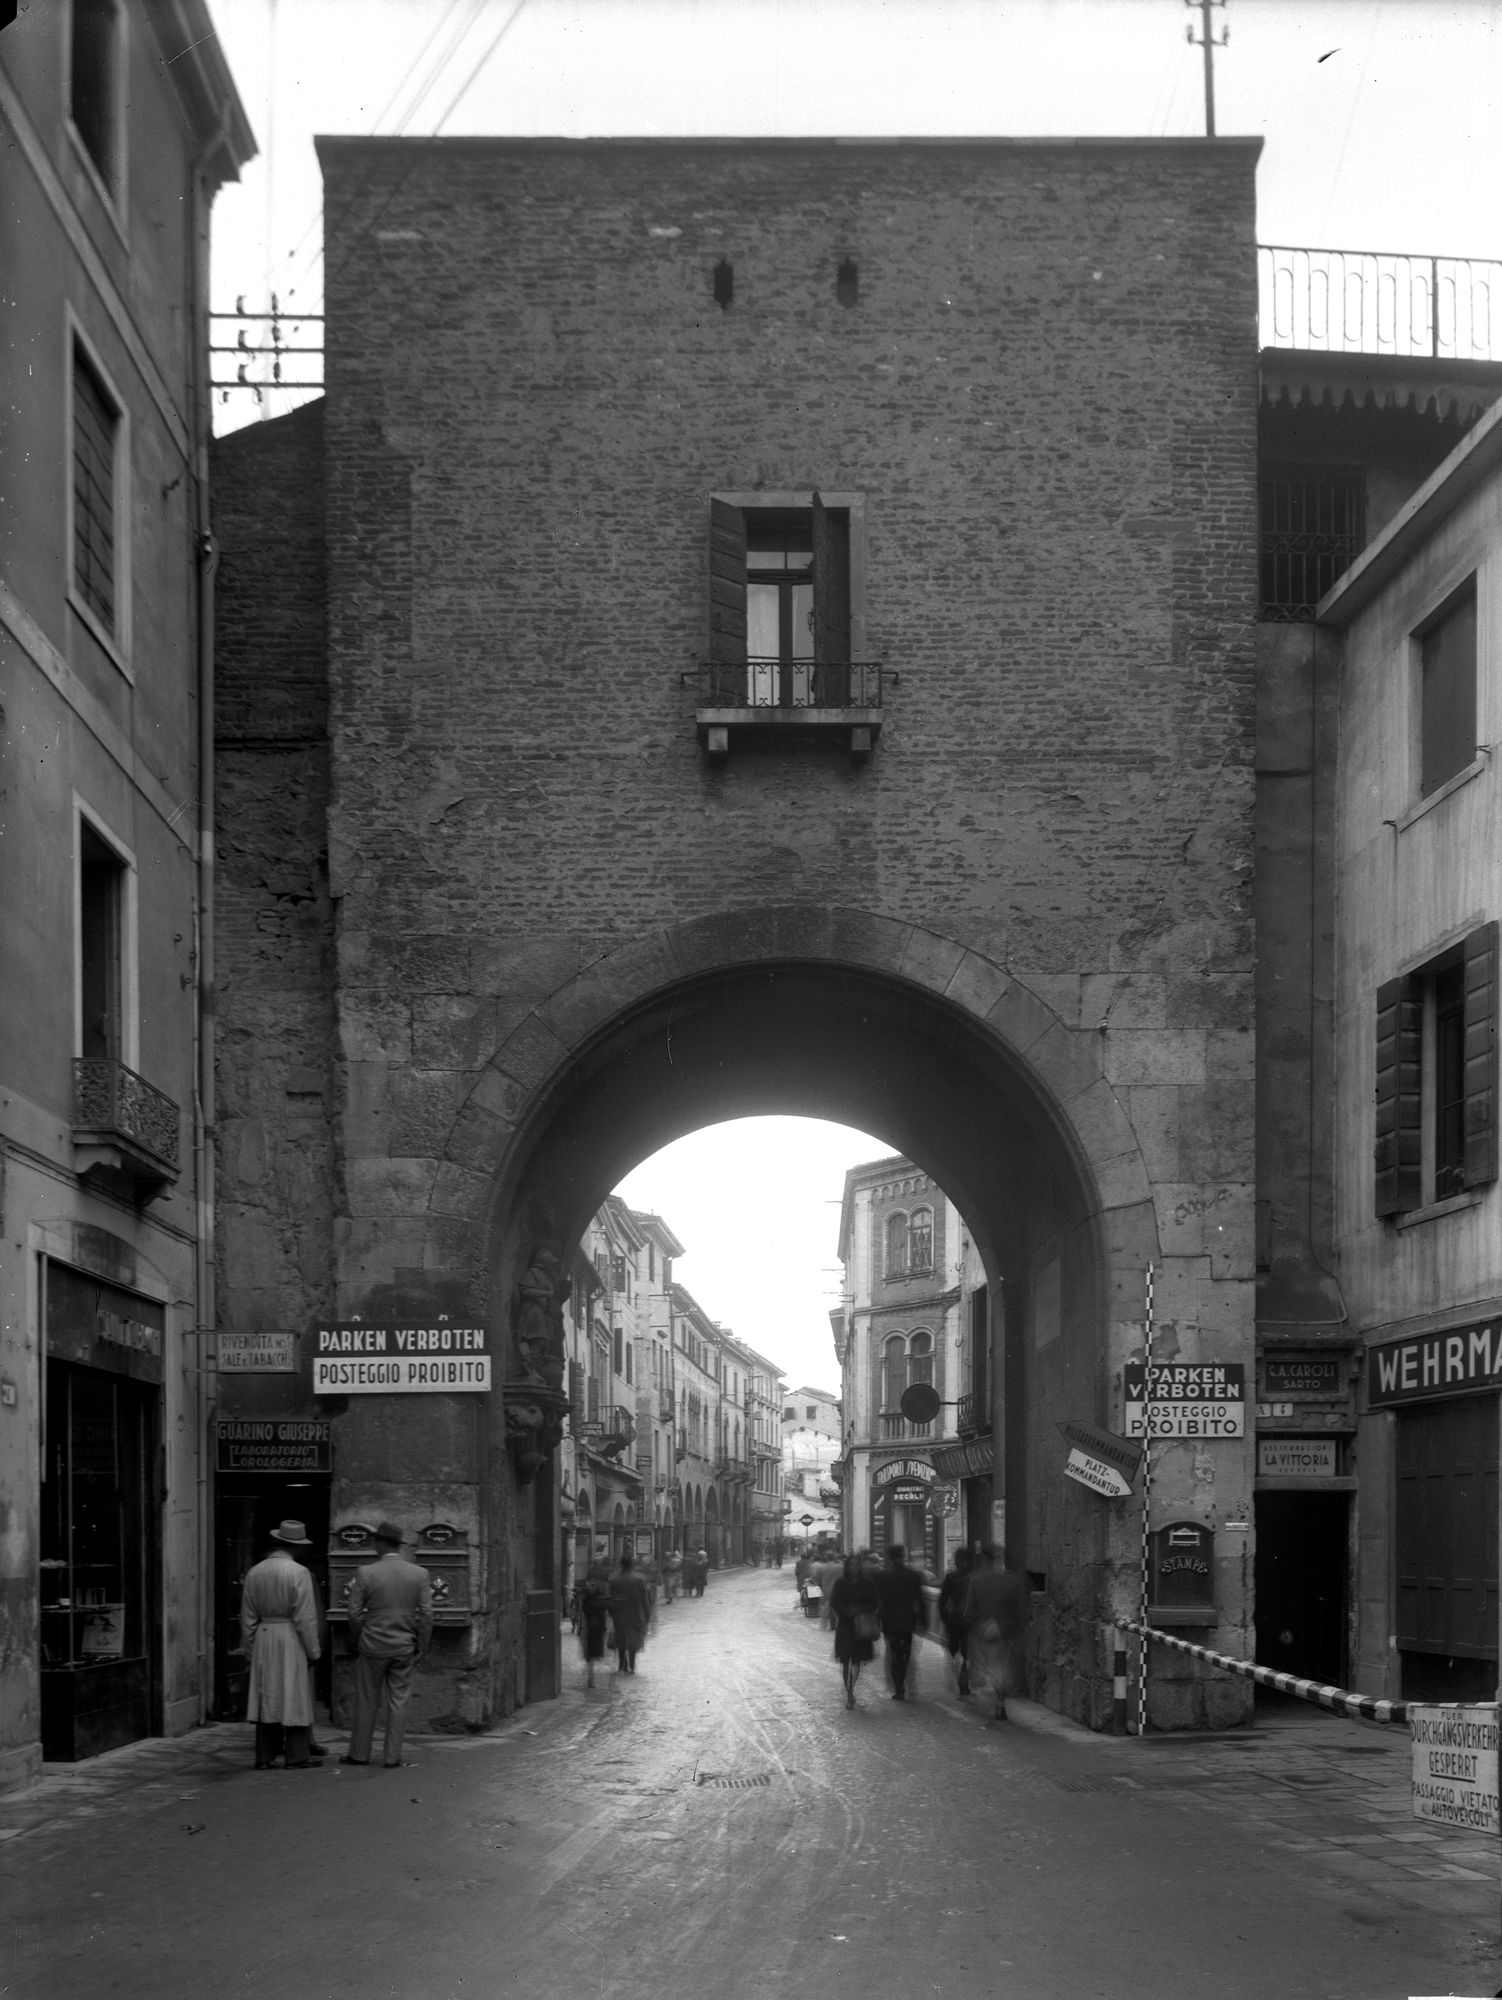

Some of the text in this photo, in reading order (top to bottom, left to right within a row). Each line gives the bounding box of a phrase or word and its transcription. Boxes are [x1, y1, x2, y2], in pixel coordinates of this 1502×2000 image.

[319, 1329, 484, 1351] PARKEN VERBOTEN
[319, 1362, 485, 1384] POSTEGGIO PROIBITO
[1149, 1367, 1225, 1383] PARKEN
[1282, 1379, 1321, 1389] SARTO
[218, 1423, 329, 1441] GUARINO GIUSEPPE
[1131, 1419, 1237, 1435] PROIBITO
[233, 1446, 310, 1456] LABORATORIO
[240, 1456, 316, 1467] OROLOGERIA
[1265, 1454, 1329, 1466] LA VITTORIA
[1066, 1462, 1121, 1495] KOMMANDANTUR
[1163, 1557, 1207, 1574] STAMPE
[1441, 1711, 1464, 1721] FUER
[1429, 1750, 1478, 1778] GESPERRT
[1412, 1780, 1456, 1805] PASSAGGIO
[1459, 1789, 1499, 1812] VIETATO
